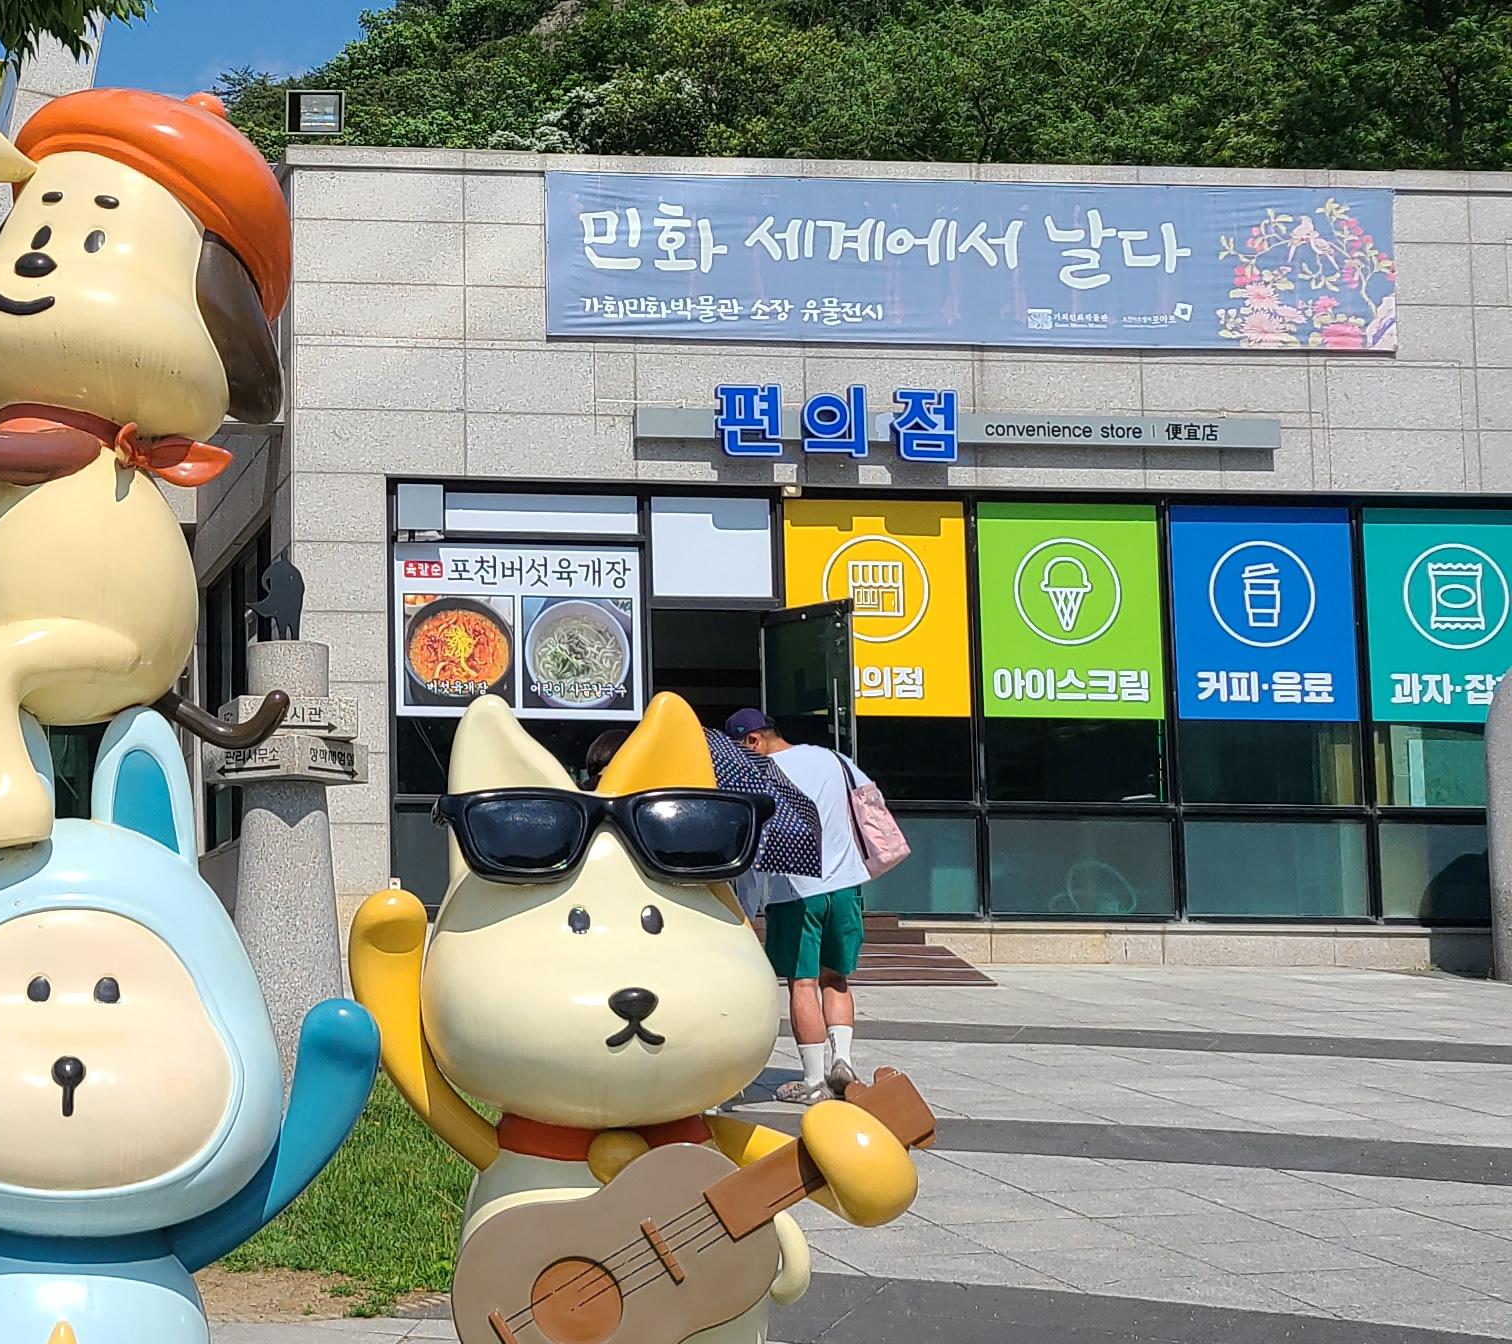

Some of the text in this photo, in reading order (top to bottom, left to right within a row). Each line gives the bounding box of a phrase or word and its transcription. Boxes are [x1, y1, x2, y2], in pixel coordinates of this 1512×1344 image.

[579, 203, 1192, 290] 민화 세계에서 날다
[579, 296, 884, 325] 가회민화박물관 소장 유물전시
[716, 384, 958, 462] 편의점
[984, 421, 1143, 439] convenience store
[1165, 422, 1219, 442] 便宜店
[447, 555, 632, 589] 포천버섯육개장
[426, 679, 489, 695] 버섯육개장
[530, 682, 564, 697] 어린이
[854, 666, 924, 700] 의점
[992, 667, 1151, 702] 아이스크림
[1196, 670, 1335, 704] 커피·음료
[1390, 673, 1506, 705] 과자·잡
[283, 707, 323, 723] 시관
[224, 747, 280, 765] 관리사무소
